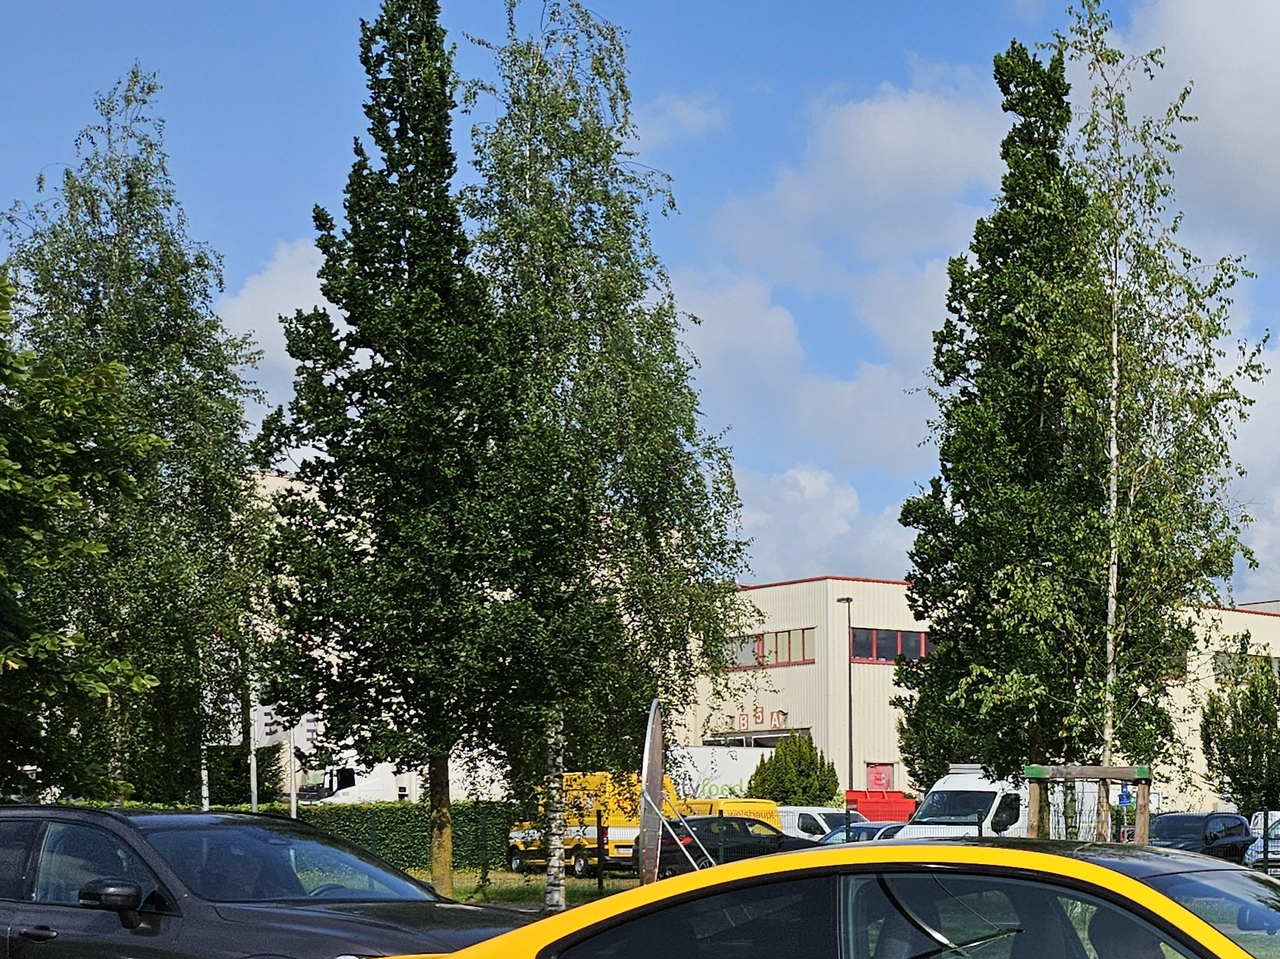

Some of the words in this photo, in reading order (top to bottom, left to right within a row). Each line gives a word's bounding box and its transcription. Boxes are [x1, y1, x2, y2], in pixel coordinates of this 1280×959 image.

[740, 714, 748, 730] B
[771, 713, 780, 728] A
[699, 777, 743, 797] food
